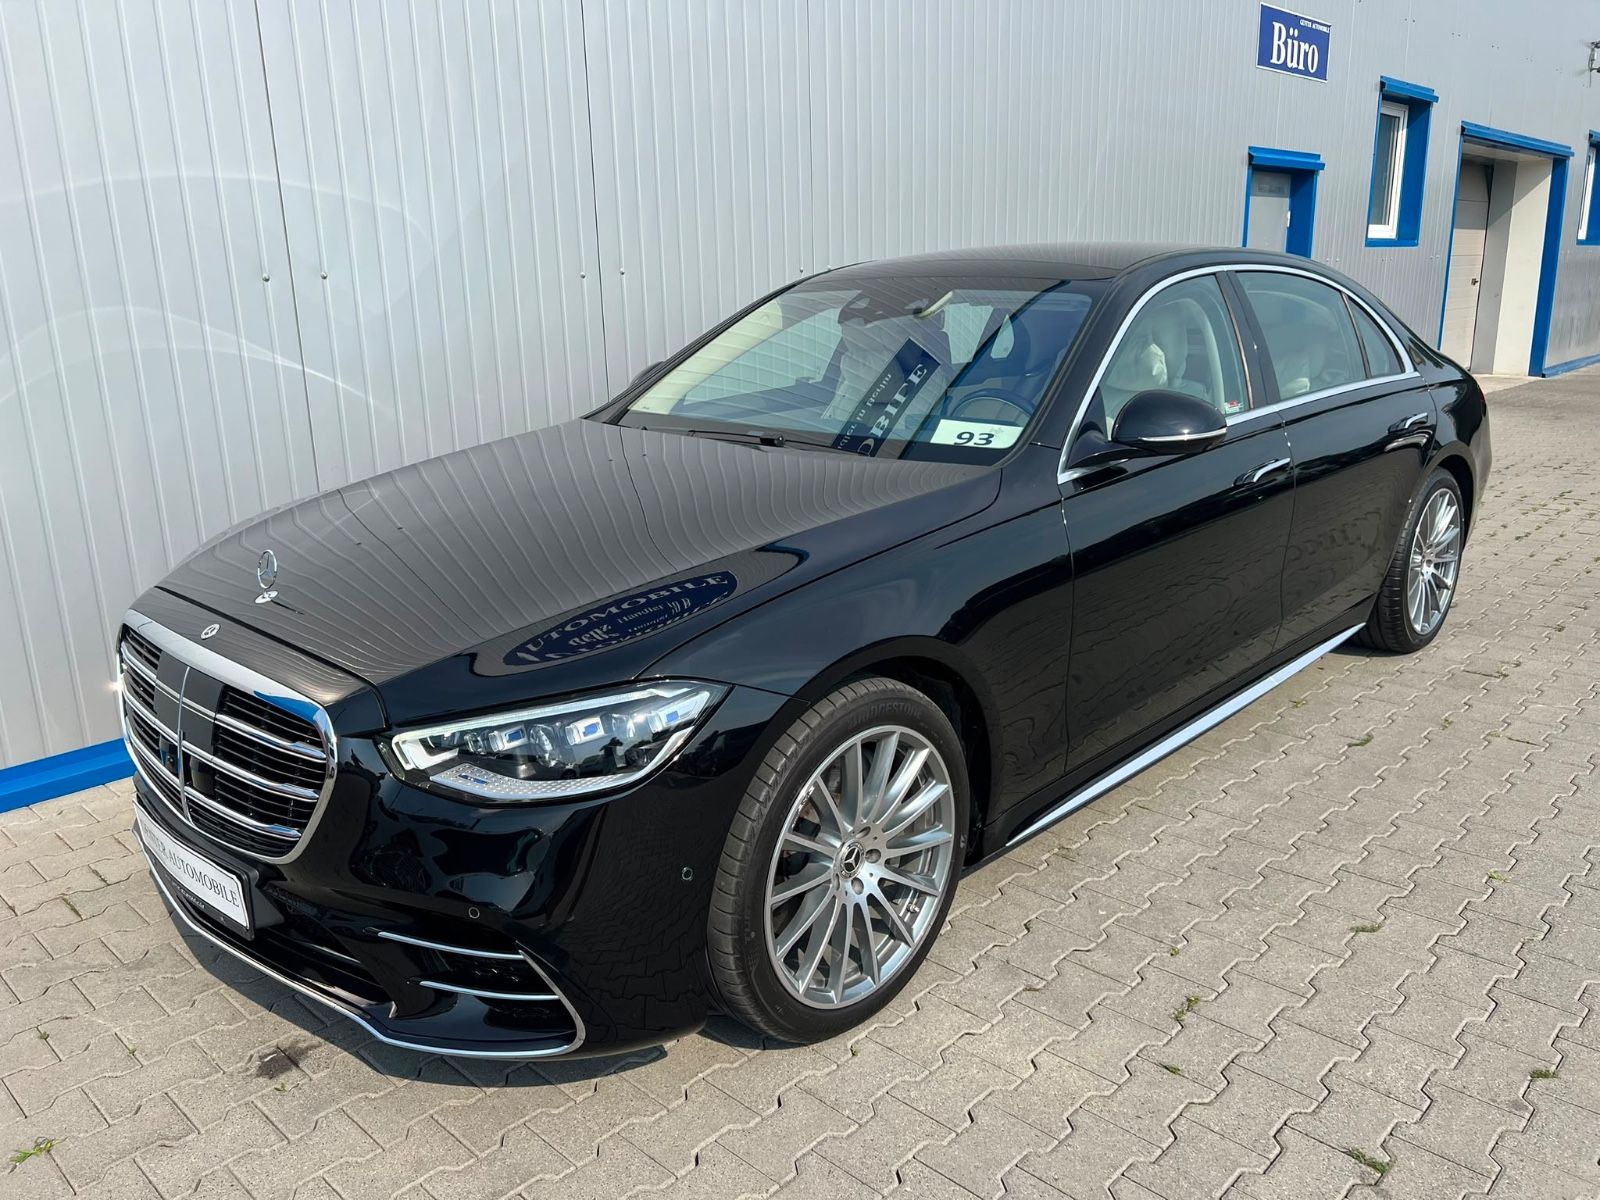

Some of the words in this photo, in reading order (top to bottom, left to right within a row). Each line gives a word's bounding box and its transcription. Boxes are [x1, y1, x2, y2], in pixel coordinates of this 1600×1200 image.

[1270, 21, 1319, 73] Büro
[953, 431, 995, 446] 93
[168, 848, 240, 908] AUTOMOBILE
